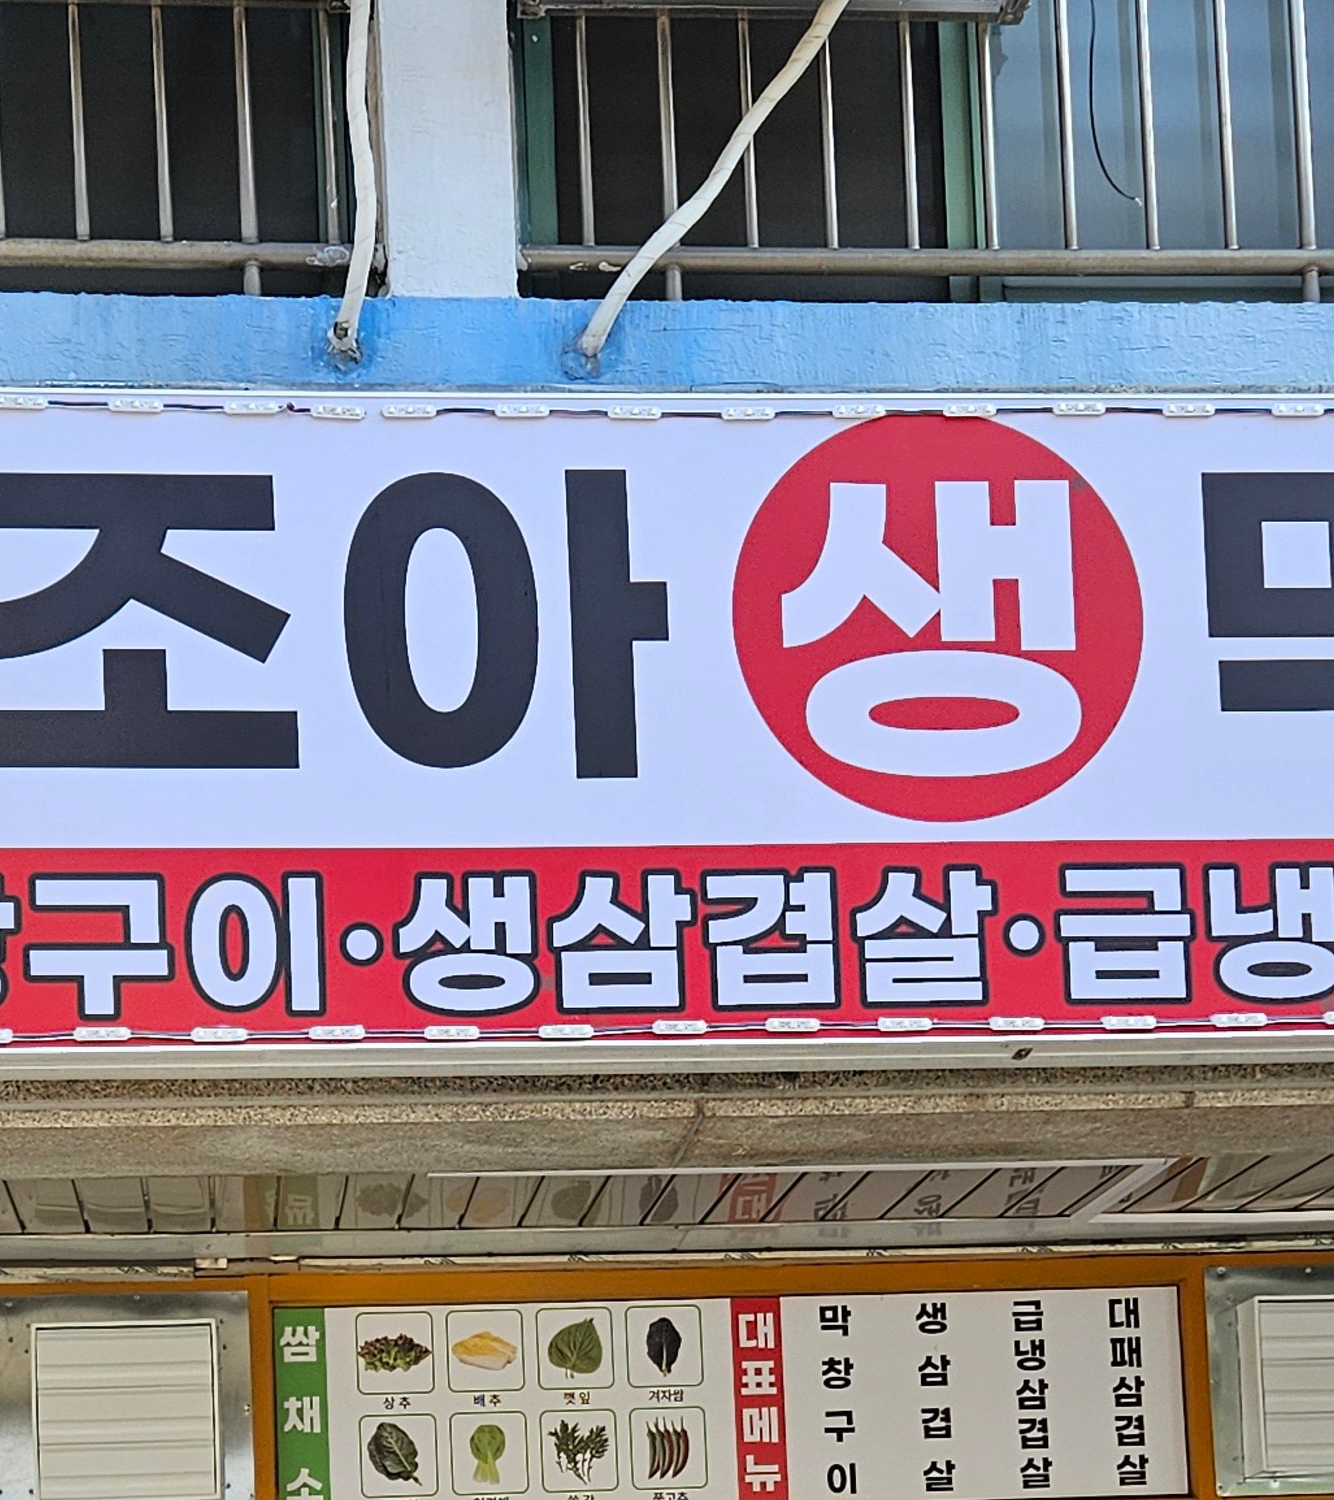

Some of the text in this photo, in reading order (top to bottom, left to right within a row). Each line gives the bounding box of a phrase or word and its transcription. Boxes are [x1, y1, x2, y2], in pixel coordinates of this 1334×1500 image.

[737, 1312, 782, 1493] 대표메뉴
[1012, 1300, 1052, 1489] 급냉삼겹살
[1108, 1297, 1149, 1487] 대패삼겹살
